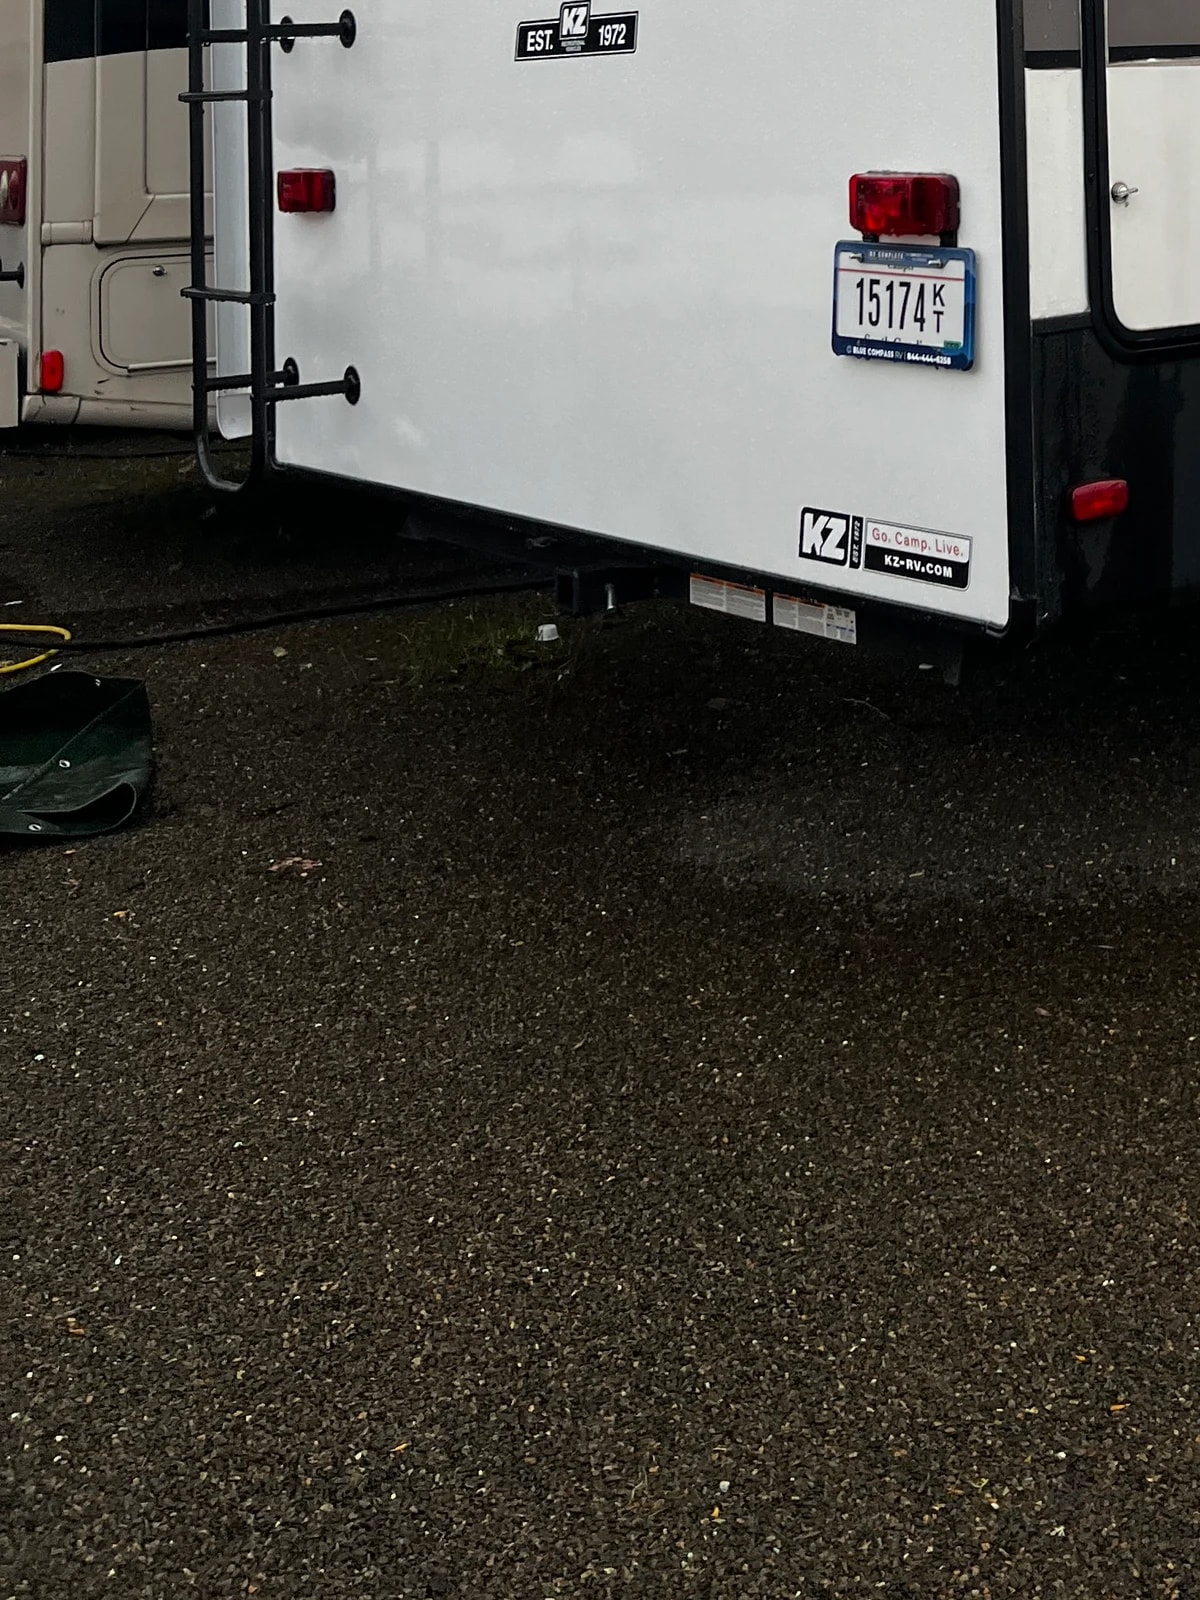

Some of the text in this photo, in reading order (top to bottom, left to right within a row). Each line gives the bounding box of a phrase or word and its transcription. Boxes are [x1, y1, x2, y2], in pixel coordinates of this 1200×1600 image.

[562, 6, 588, 36] KZ
[526, 29, 554, 52] EST.
[598, 23, 627, 47] 1972
[856, 277, 926, 333] 15174
[852, 346, 867, 355] BLUE
[867, 347, 894, 359] COMPASS
[802, 512, 847, 561] KZ
[852, 520, 861, 542] 1972
[872, 527, 964, 557] Go. Camp. Live.
[884, 554, 953, 578] KZ-RV.COM
